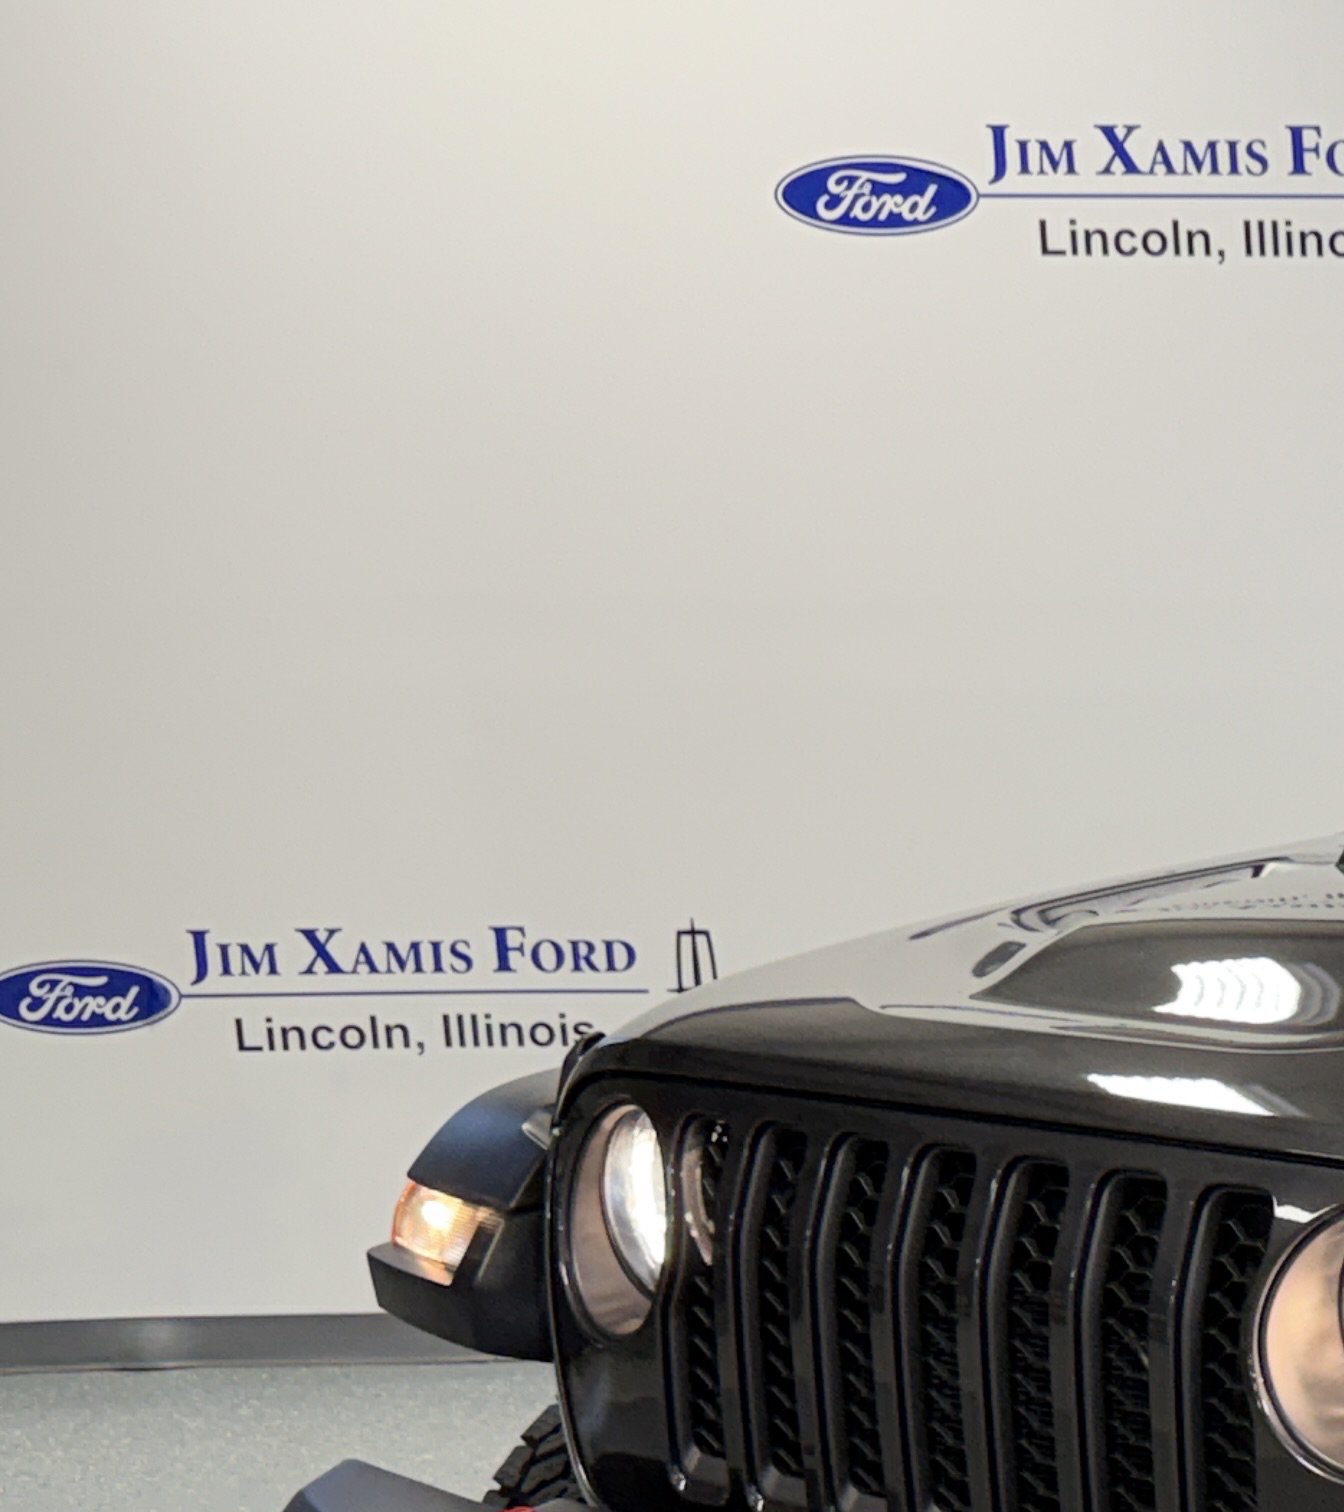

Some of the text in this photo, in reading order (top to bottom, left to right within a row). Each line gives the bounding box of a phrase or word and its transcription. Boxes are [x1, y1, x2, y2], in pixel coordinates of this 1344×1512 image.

[815, 168, 938, 223] Ford
[1038, 218, 1226, 265] Lincoln,
[18, 973, 141, 1023] Ford
[234, 1014, 426, 1056] Lincoln,
